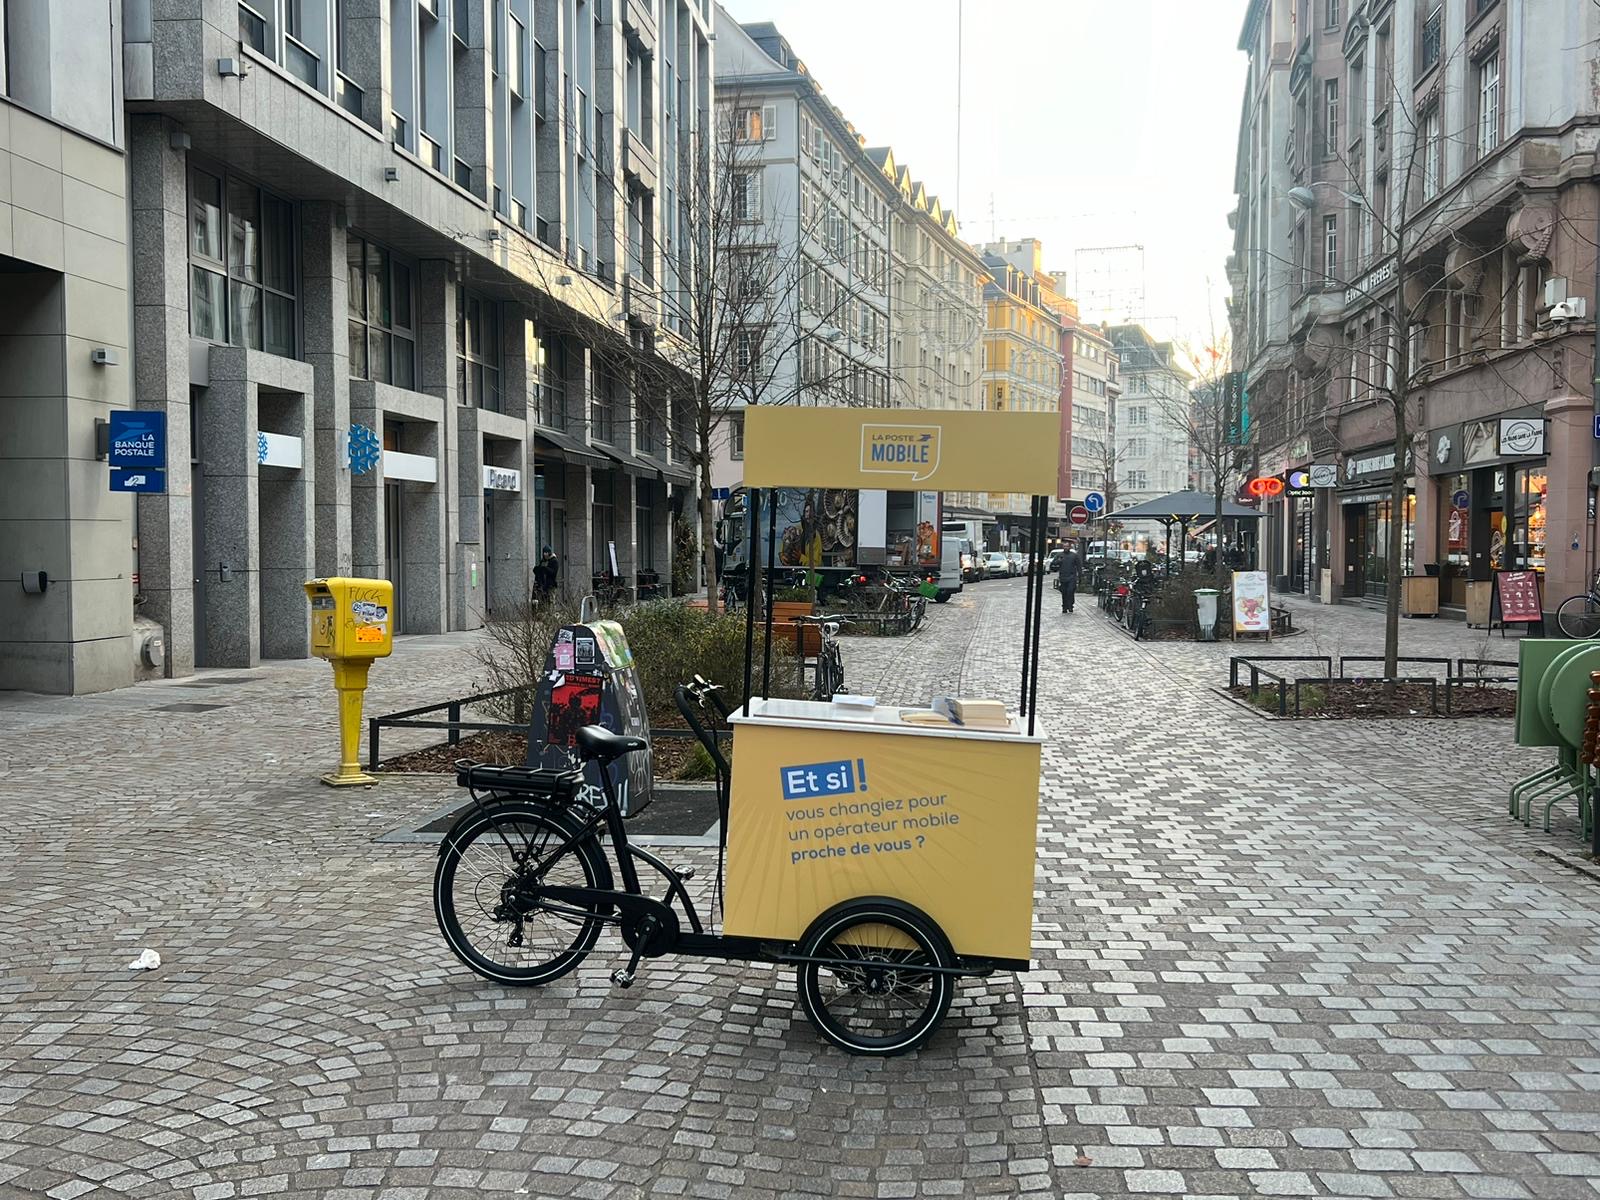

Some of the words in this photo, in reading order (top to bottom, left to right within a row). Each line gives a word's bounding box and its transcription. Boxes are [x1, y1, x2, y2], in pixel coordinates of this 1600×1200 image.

[114, 441, 155, 449] BANQUE
[142, 433, 155, 441] LA
[885, 434, 915, 442] POSTE
[114, 448, 155, 457] POSTALE
[489, 468, 517, 490] Picard
[349, 586, 384, 603] FUCK
[787, 769, 820, 794] Et
[826, 765, 848, 790] si
[785, 806, 825, 821] vous
[829, 797, 904, 817] changiez
[908, 793, 947, 812] pour
[788, 828, 809, 841] un
[813, 818, 898, 841] opérateur
[902, 812, 960, 829] mobile
[791, 844, 846, 865] proche
[850, 841, 871, 855] de
[874, 838, 912, 853] vous
[915, 835, 925, 848] ?
